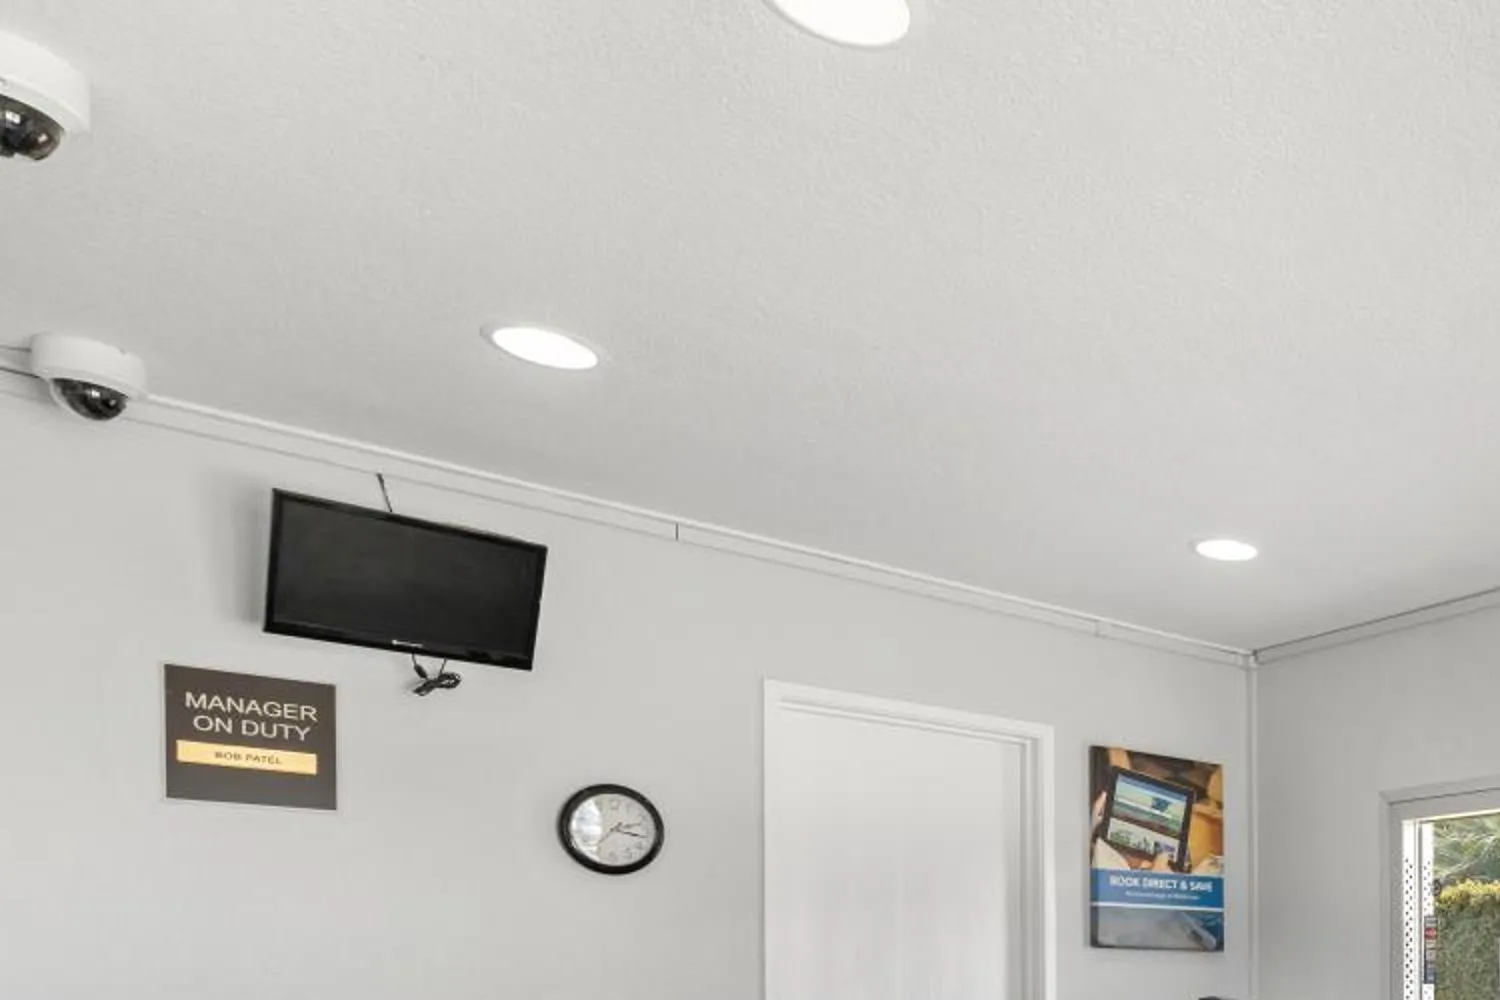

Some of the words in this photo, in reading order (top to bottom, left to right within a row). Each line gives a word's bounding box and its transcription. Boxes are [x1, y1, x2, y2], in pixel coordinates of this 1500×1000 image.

[185, 691, 318, 722] MANAGER
[193, 715, 233, 734] ON
[241, 719, 311, 741] DUTY
[214, 751, 242, 760] BOB
[245, 753, 282, 765] PATEL
[1109, 875, 1139, 887] BOOK
[1142, 876, 1177, 889] DIRECT
[1189, 881, 1213, 892] SAVE
